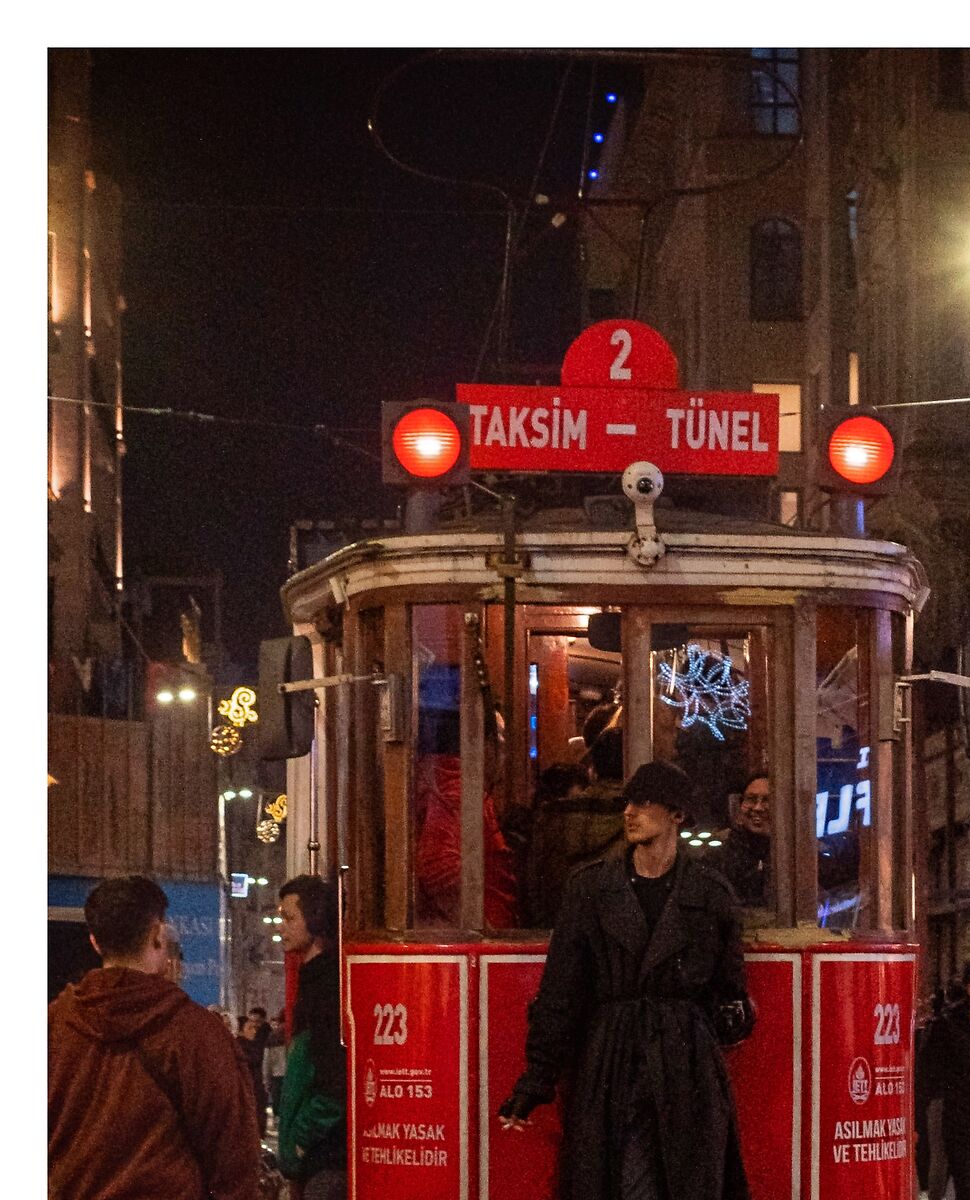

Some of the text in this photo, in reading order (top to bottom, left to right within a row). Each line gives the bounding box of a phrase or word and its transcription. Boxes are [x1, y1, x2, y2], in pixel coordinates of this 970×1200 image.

[609, 329, 633, 381] 2
[469, 398, 588, 450] TAKSİM
[666, 399, 769, 453] TÜNEL
[373, 1003, 408, 1045] 223
[874, 1003, 900, 1045] 223
[379, 1084, 403, 1099] ALO
[407, 1084, 433, 1099] 153
[402, 1123, 446, 1141] YASAK
[834, 1119, 885, 1140] ASILMAK
[833, 1144, 850, 1163] VE
